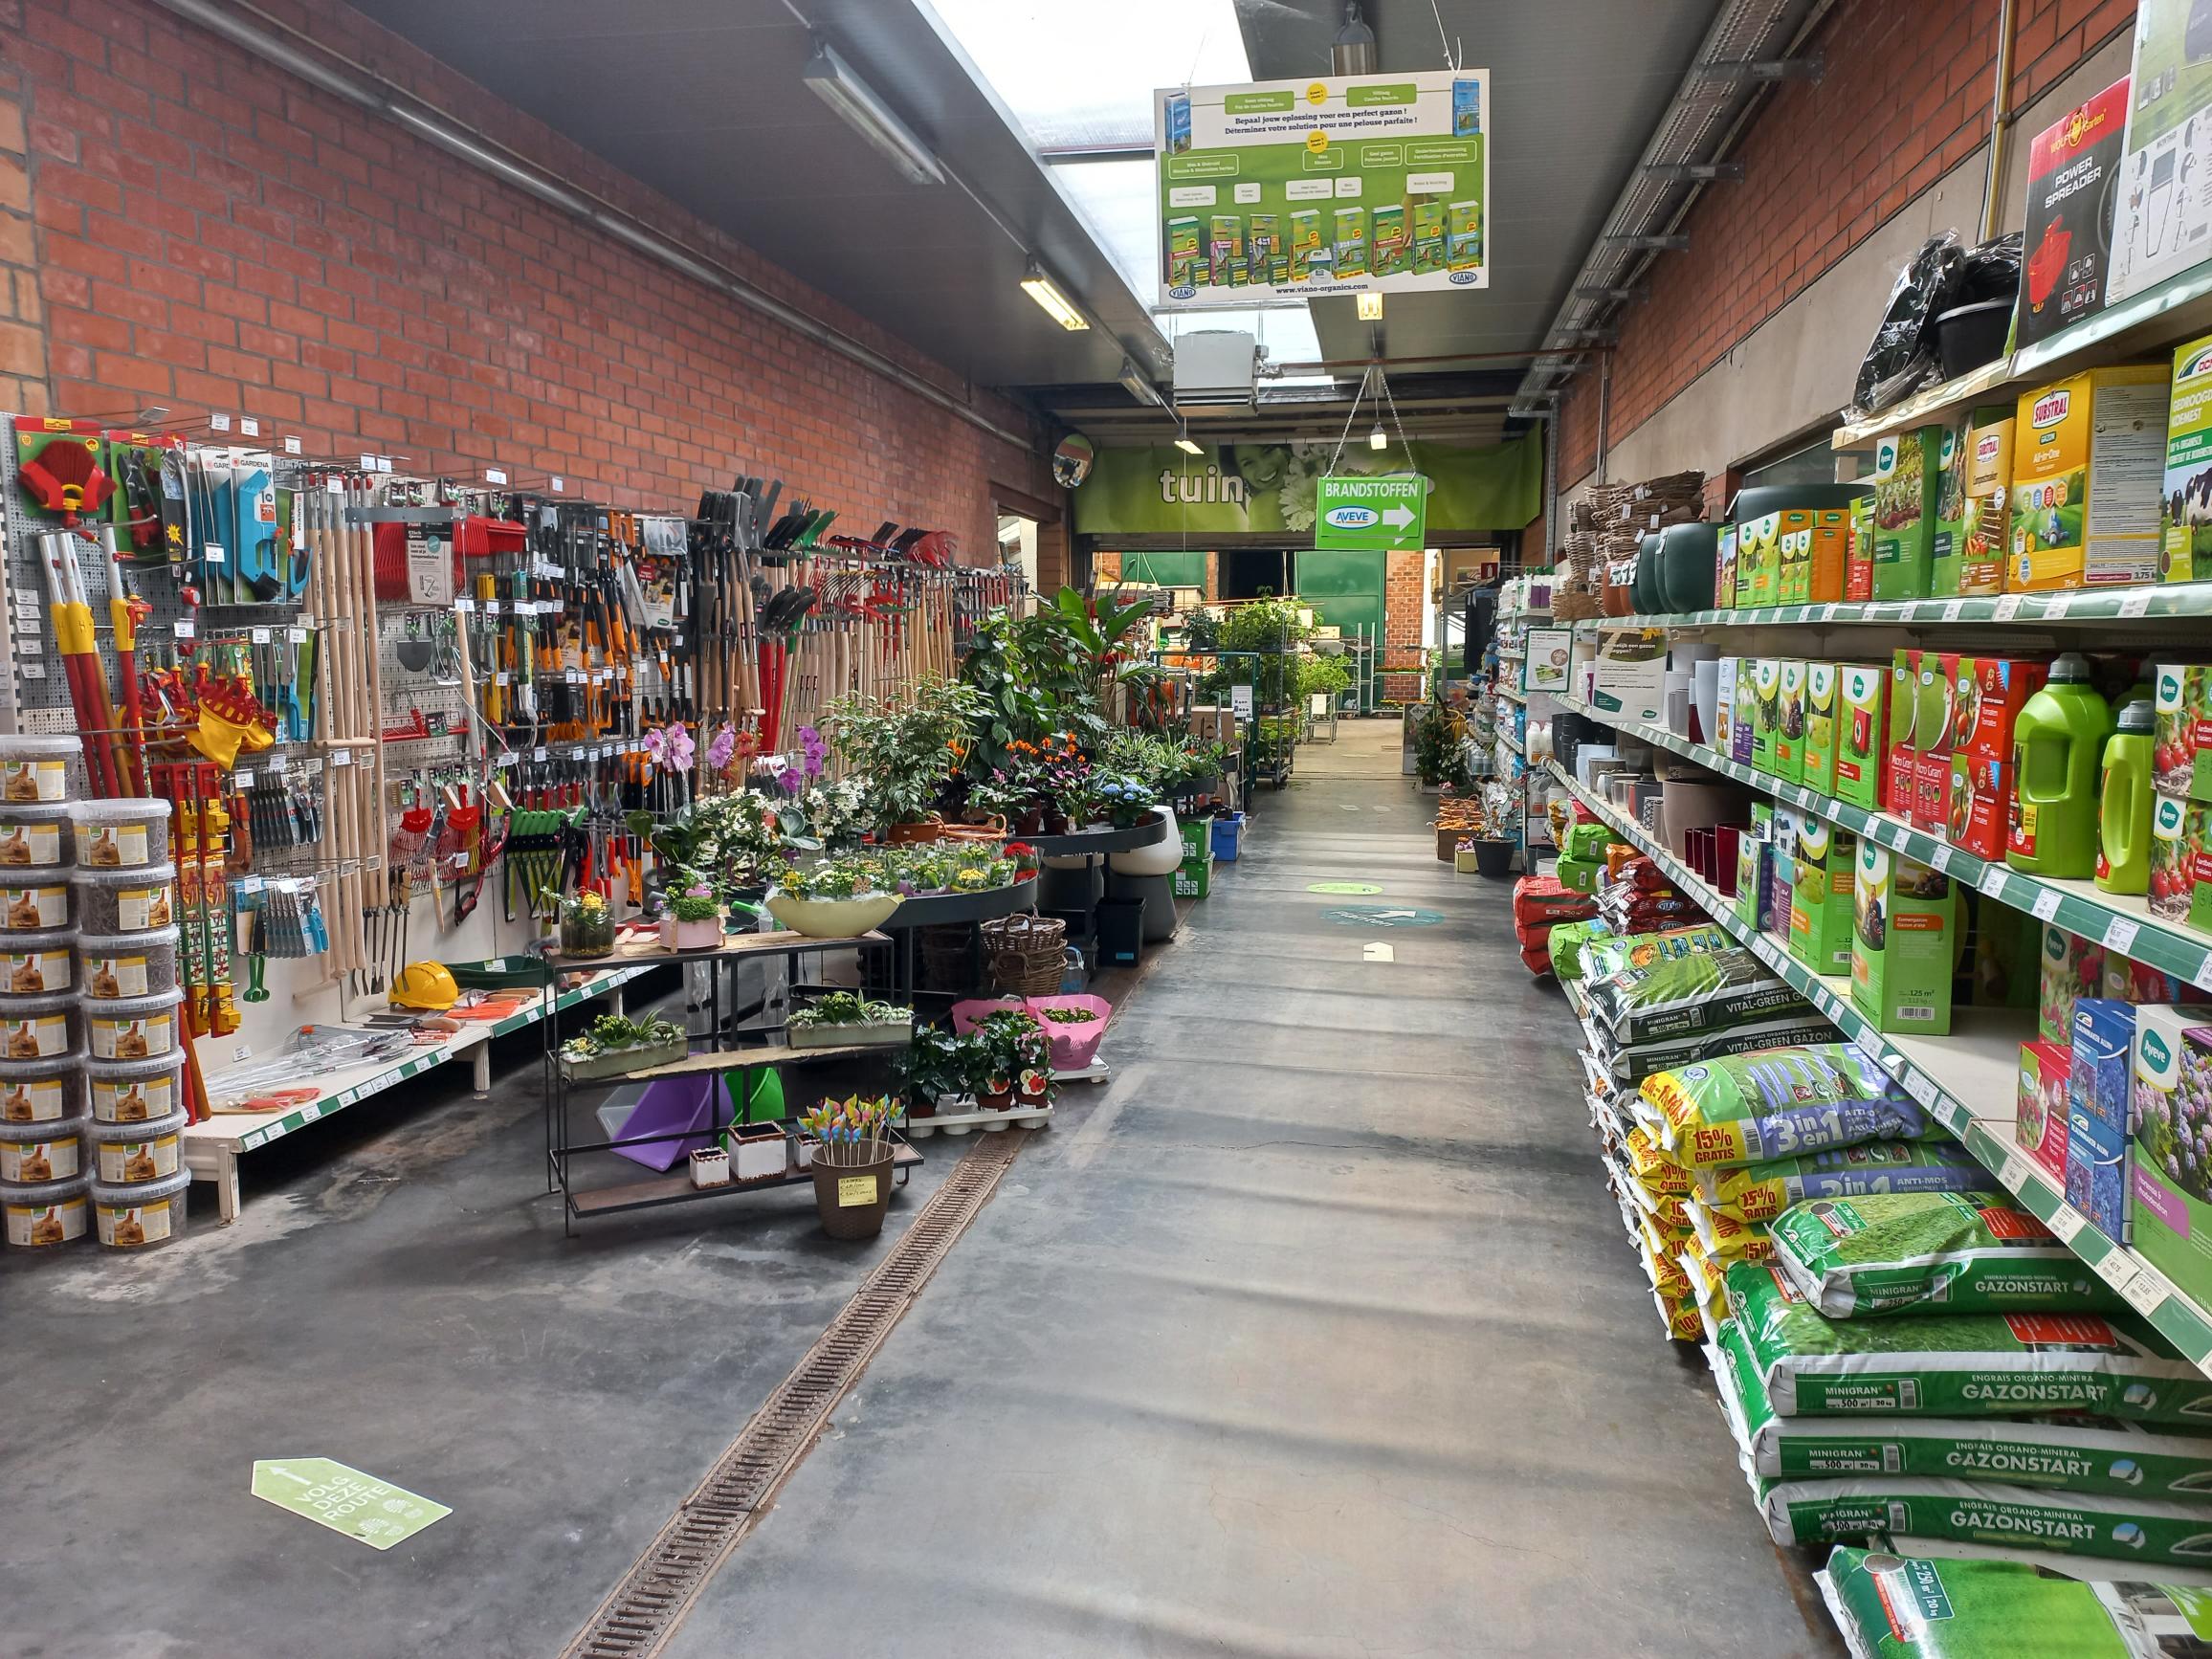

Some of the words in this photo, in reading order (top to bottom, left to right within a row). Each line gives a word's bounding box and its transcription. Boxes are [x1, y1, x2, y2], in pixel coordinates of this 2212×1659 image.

[1225, 124, 1267, 134] Déterminez
[1354, 119, 1382, 128] pelouse
[1383, 118, 1413, 126] parfaite
[1235, 117, 1261, 125] Bepaal
[1262, 116, 1280, 124] jouw
[1282, 114, 1317, 122] oplossing
[1352, 110, 1379, 119] perfect
[2083, 112, 2106, 132] Garten
[2055, 156, 2093, 188] POWER
[2045, 166, 2102, 209] SPREADER
[1452, 274, 1474, 282] VIANO
[1171, 288, 1194, 299] VIANO
[1275, 282, 1369, 295] www.viano-organics.com
[2173, 388, 2212, 412] GEDROOGD
[2034, 396, 2068, 423] SUBSTRAL
[1159, 465, 1245, 504] tuin
[1324, 482, 1419, 498] BRANDSTOFFEN
[1336, 511, 1370, 523] AVEVE
[2134, 571, 2151, 580] 3,75
[1726, 994, 1790, 1013] VITAL-GREEN
[1647, 1015, 1679, 1026] MINIGRAN
[1656, 1024, 1667, 1032] 500
[1727, 1035, 1791, 1053] VITAL-GREEN
[1793, 1031, 1832, 1044] GAZON
[2144, 1041, 2166, 1063] Aveve
[1692, 1127, 1733, 1149] 15%
[1775, 1117, 1799, 1152] 3
[1796, 1114, 1817, 1133] in
[1820, 1110, 1844, 1142] 1
[1803, 1132, 1825, 1146] en
[1694, 1148, 1735, 1163] GRATIS
[1845, 1177, 1866, 1195] in
[1897, 1177, 1948, 1185] ANTI-MOS
[2138, 1175, 2157, 1197] Hortensia
[1741, 1185, 1777, 1208] 15%
[2138, 1185, 2168, 1218] rhododendron
[1869, 1285, 1920, 1295] MINIGRAN
[1975, 1280, 2069, 1294] GAZONSTART
[1972, 1374, 2010, 1382] ENGRAIS
[2013, 1374, 2094, 1382] ORGANO-MINERA
[1825, 1386, 1881, 1396] MINIGRAN
[1961, 1384, 2108, 1402] GAZONSTART
[1841, 1398, 1858, 1407] 500
[1808, 1449, 1864, 1458] MINIGRAN
[1996, 1445, 2081, 1459] ORGANO-MINERAL
[1946, 1451, 2093, 1477] GAZONSTART
[295, 1475, 350, 1503] VOLG
[312, 1481, 367, 1511] DEZE
[322, 1486, 391, 1521] ROUTE
[1959, 1500, 1998, 1512] ENGRAIS
[2000, 1506, 2084, 1522] ORGANO-MINERAL
[1950, 1511, 2096, 1539] GAZONSTART
[1915, 1571, 1935, 1585] 250
[1926, 1599, 1939, 1608] 20
